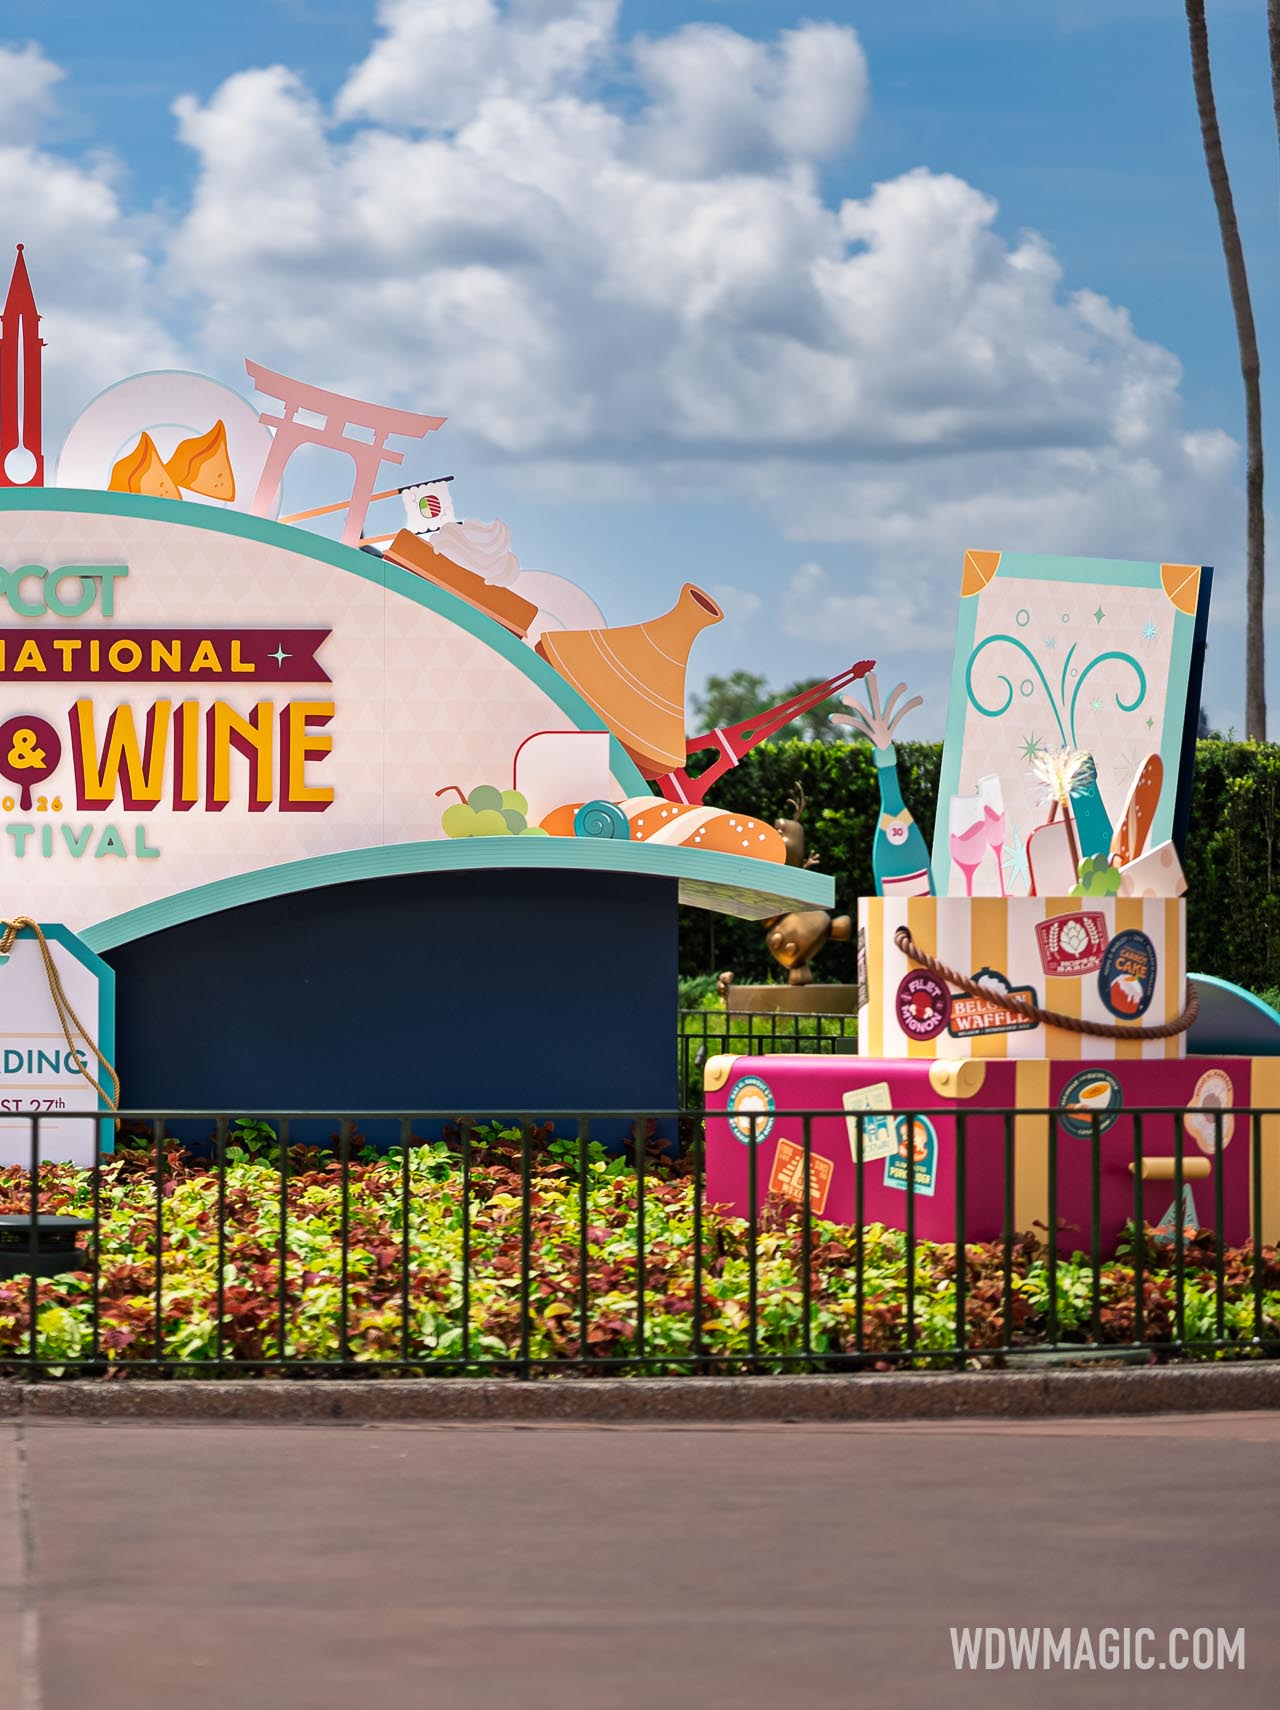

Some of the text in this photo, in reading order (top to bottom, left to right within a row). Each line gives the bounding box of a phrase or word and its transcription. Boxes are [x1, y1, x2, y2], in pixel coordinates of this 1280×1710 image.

[8, 728, 47, 769] &
[69, 699, 335, 811] WINE
[892, 827, 903, 837] 30
[1115, 957, 1148, 979] CAKE
[908, 979, 942, 997] FILET
[955, 994, 1027, 1014] BELGN
[901, 1006, 942, 1033] MIGNON
